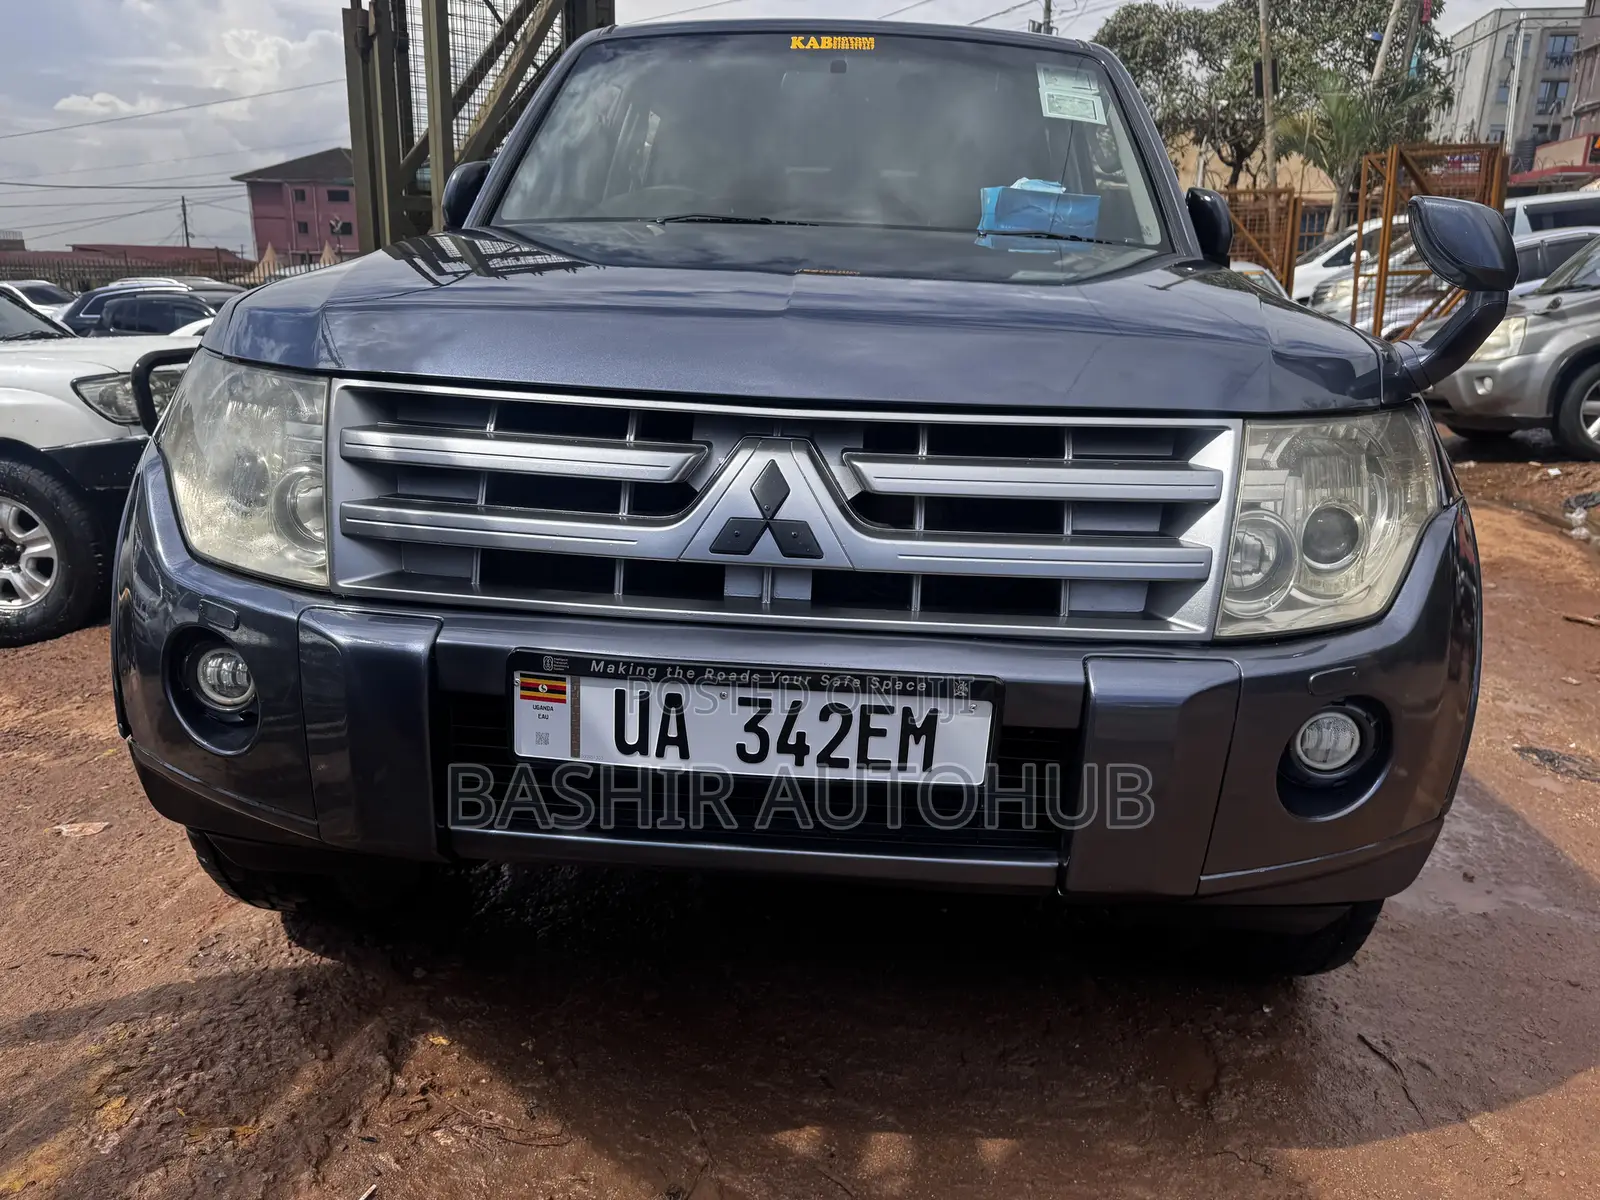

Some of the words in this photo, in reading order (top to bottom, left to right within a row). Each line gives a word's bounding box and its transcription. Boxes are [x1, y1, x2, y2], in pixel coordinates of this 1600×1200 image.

[790, 36, 832, 49] KAB
[590, 660, 657, 679] Making
[667, 666, 695, 679] the
[705, 668, 760, 682] Roads
[771, 671, 812, 685] Your
[820, 674, 861, 687] Safe
[870, 677, 927, 691] Space
[532, 704, 554, 712] UGANDA
[614, 688, 691, 760] UA
[735, 696, 939, 773] 342EM
